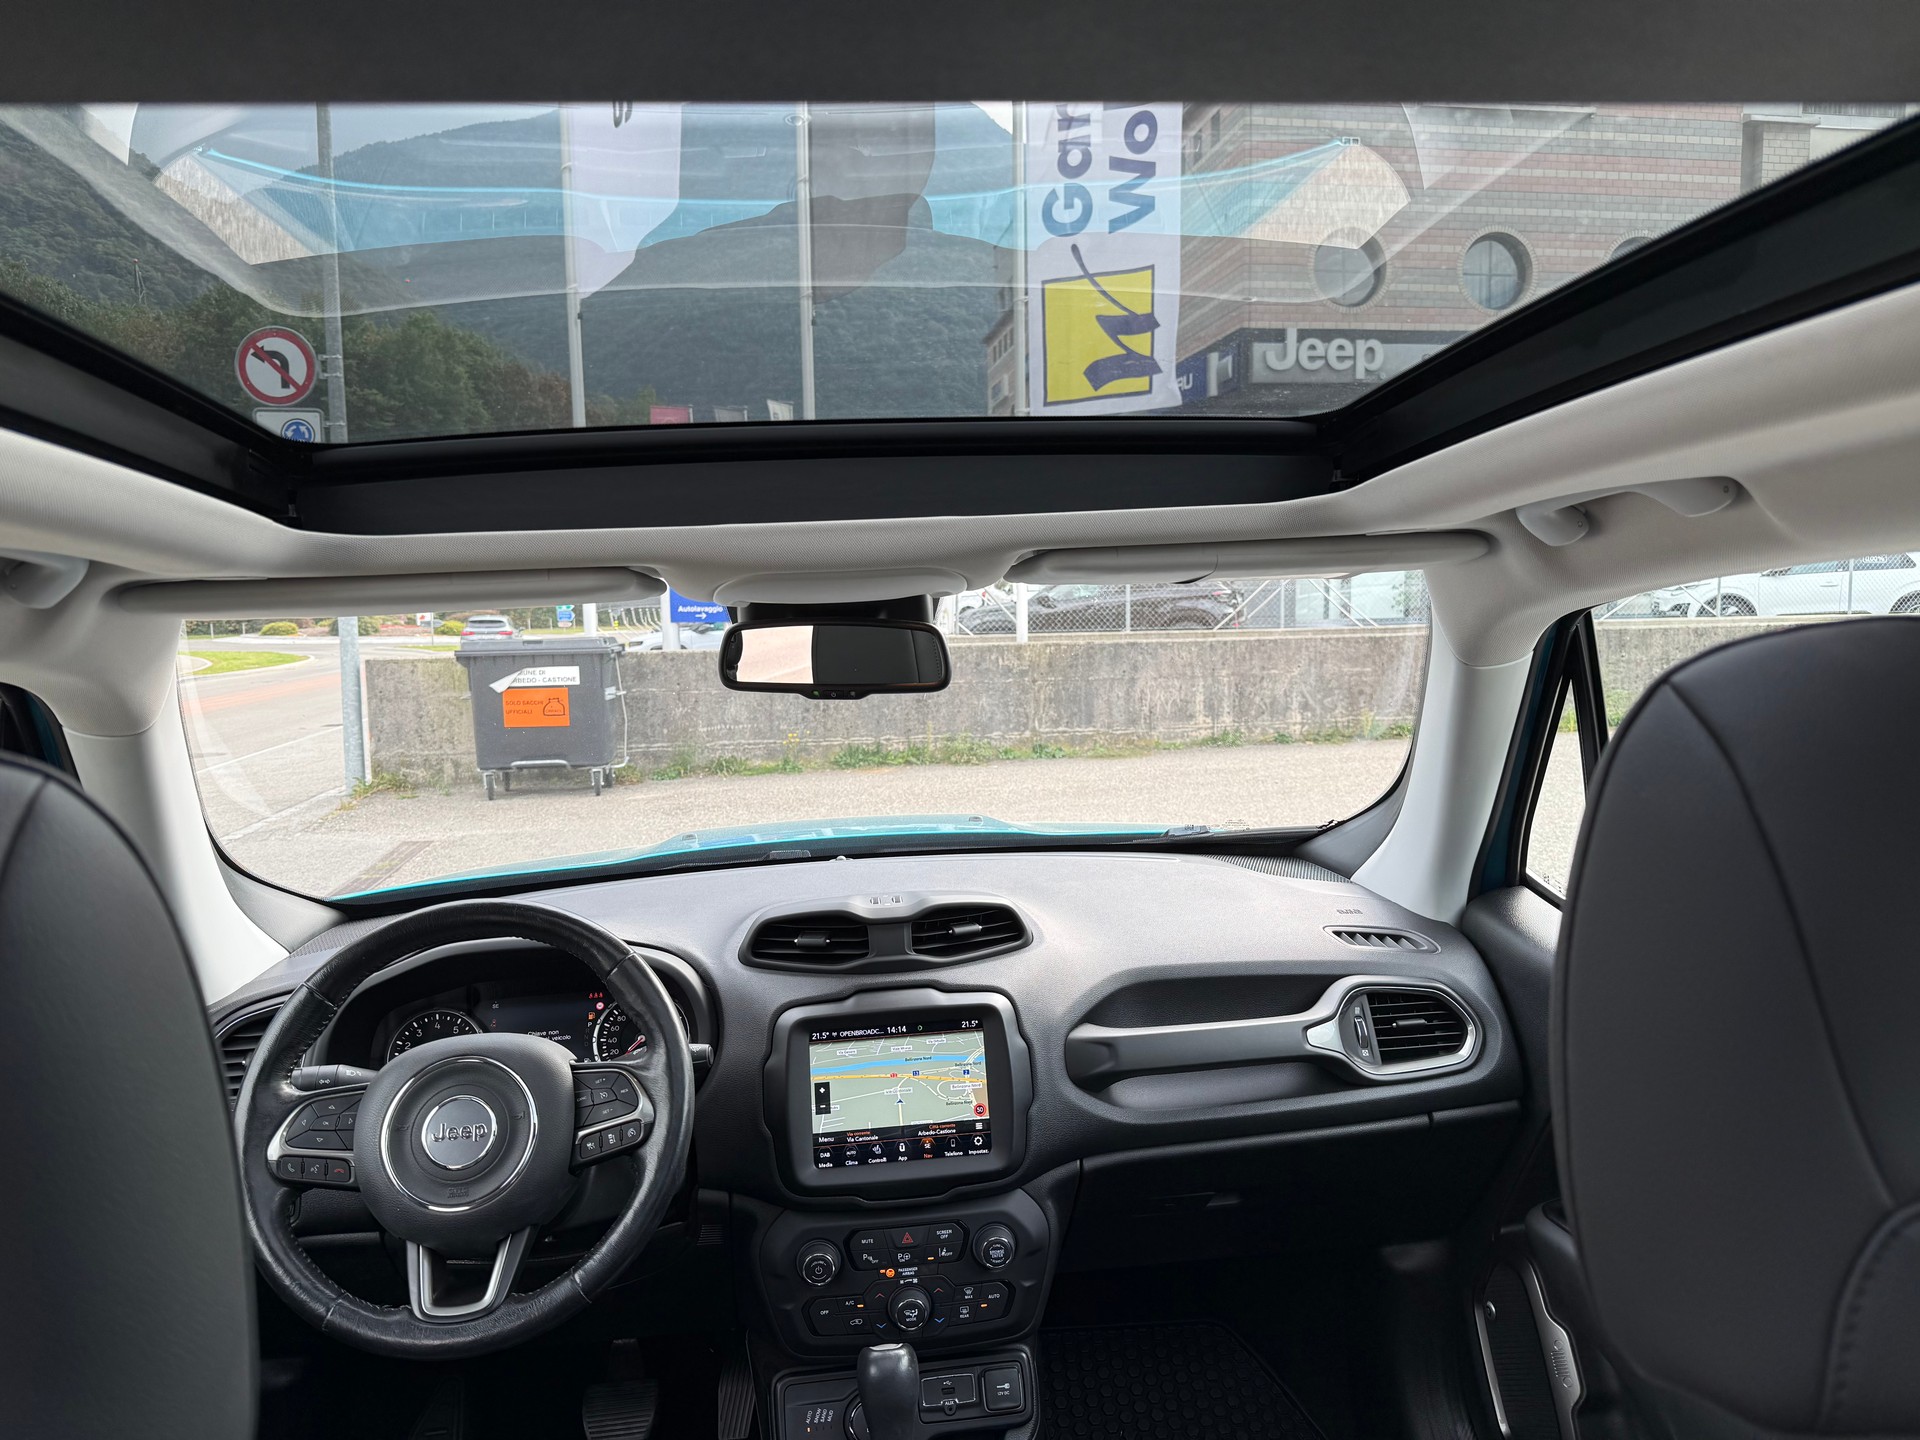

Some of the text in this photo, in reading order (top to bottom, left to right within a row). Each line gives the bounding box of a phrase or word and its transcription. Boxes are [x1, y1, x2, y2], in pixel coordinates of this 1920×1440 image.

[1265, 327, 1384, 380] Jeep
[677, 605, 724, 614] Autolavaggio
[434, 1022, 441, 1030] 4
[453, 1026, 459, 1034] 5
[887, 1025, 907, 1034] 14:14
[961, 1020, 979, 1028] 21.5°
[416, 1029, 423, 1037] 3
[404, 1042, 411, 1050] 2
[431, 1122, 488, 1143] Jeep
[805, 1410, 813, 1424] AUTO
[813, 1408, 821, 1424] SNOW
